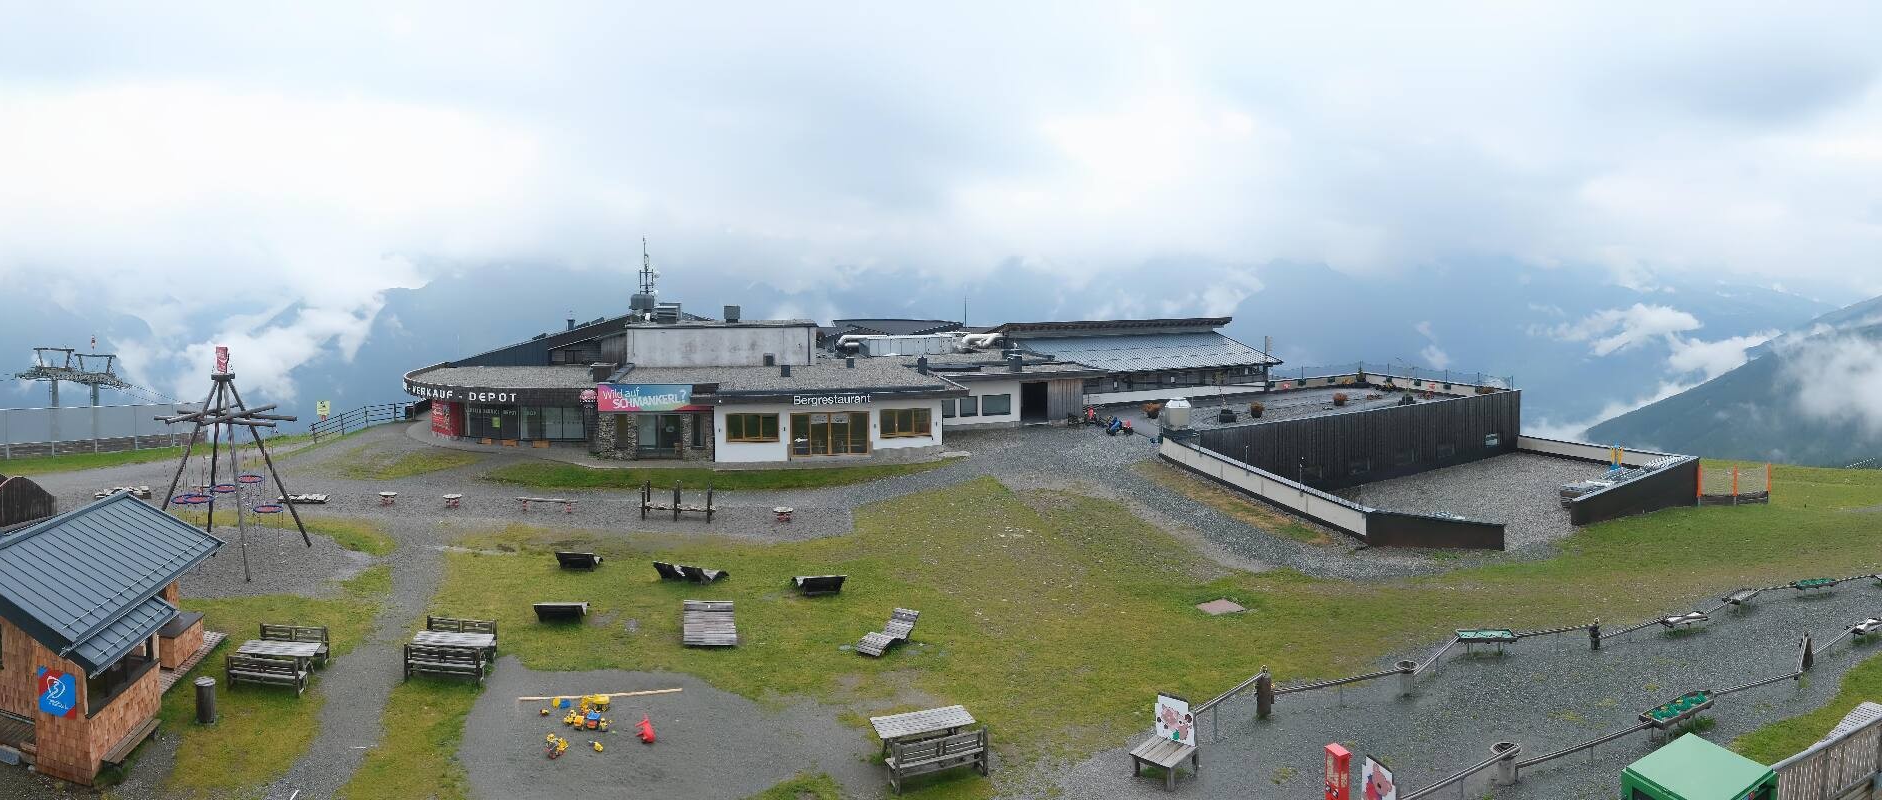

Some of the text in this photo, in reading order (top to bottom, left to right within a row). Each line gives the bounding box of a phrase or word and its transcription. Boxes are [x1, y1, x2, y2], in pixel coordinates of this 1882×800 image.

[412, 386, 453, 399] VERKAUF
[468, 391, 518, 402] DEPOT
[602, 388, 623, 400] Wild
[624, 386, 640, 398] auf
[612, 389, 687, 409] SCHMANKERL?
[793, 394, 871, 406] Bergrestaurant
